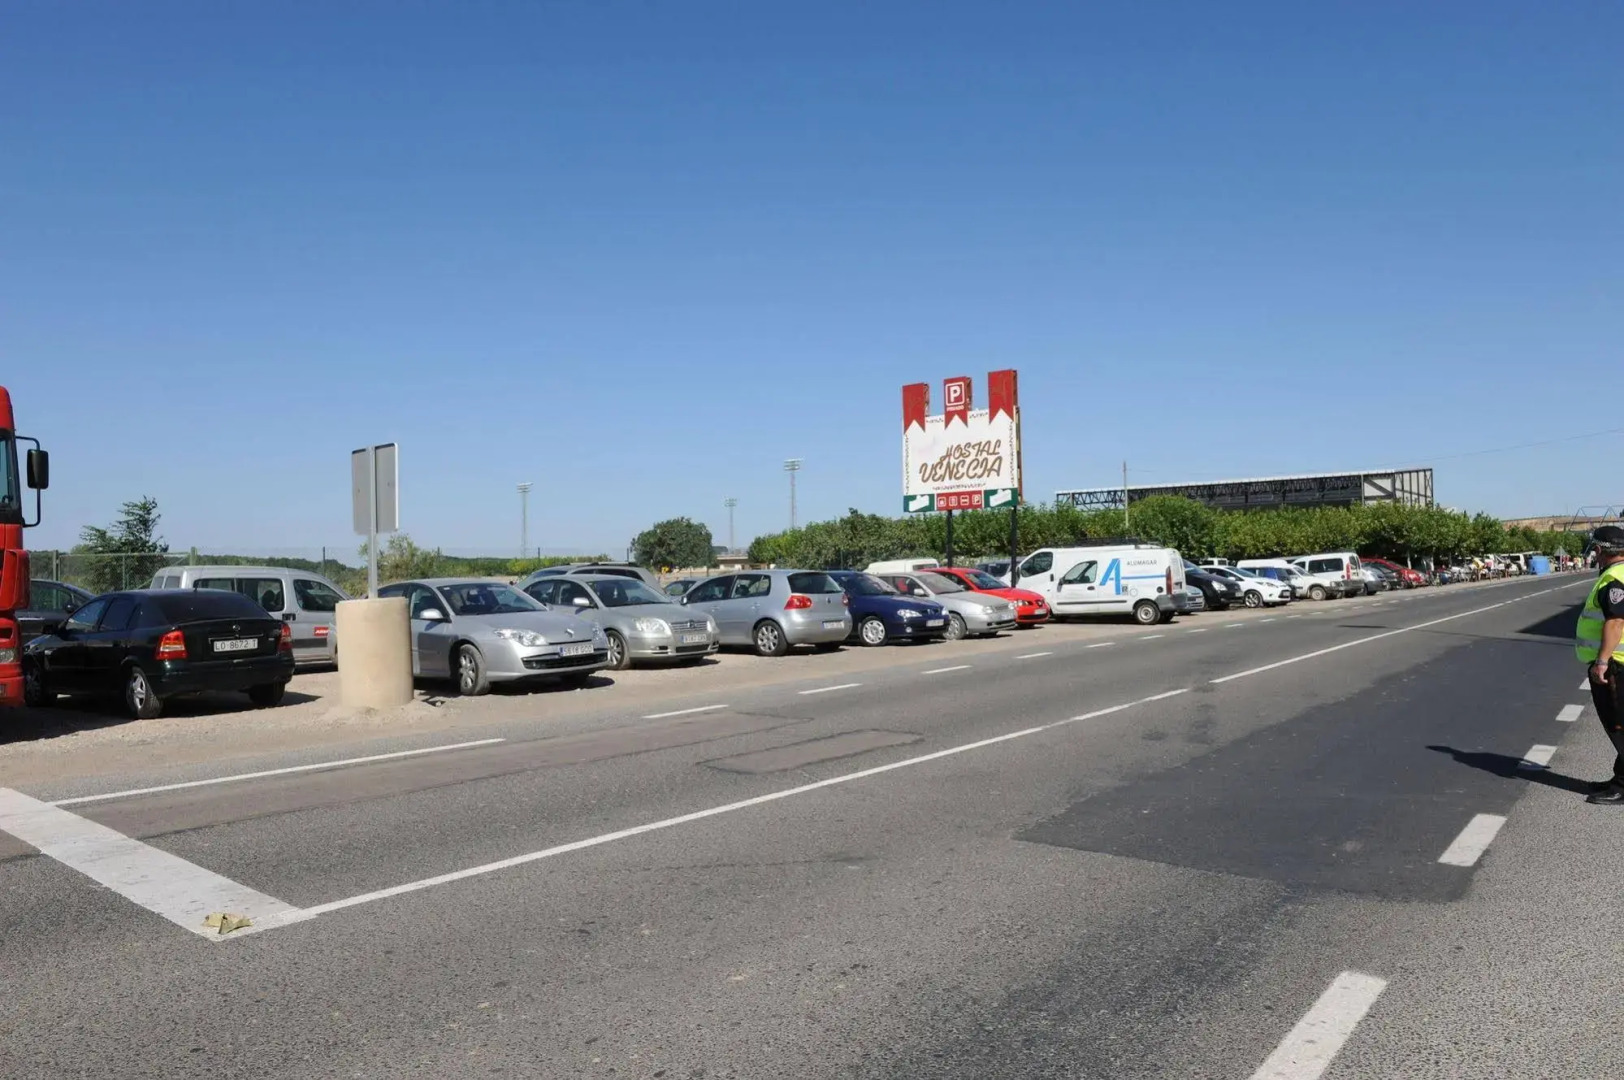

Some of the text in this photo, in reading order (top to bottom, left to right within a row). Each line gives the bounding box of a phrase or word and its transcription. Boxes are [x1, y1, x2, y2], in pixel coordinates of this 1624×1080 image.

[950, 386, 960, 402] P
[940, 439, 1001, 461] HOSTAL
[919, 455, 1002, 483] VENECIA
[229, 639, 249, 649] 8672
